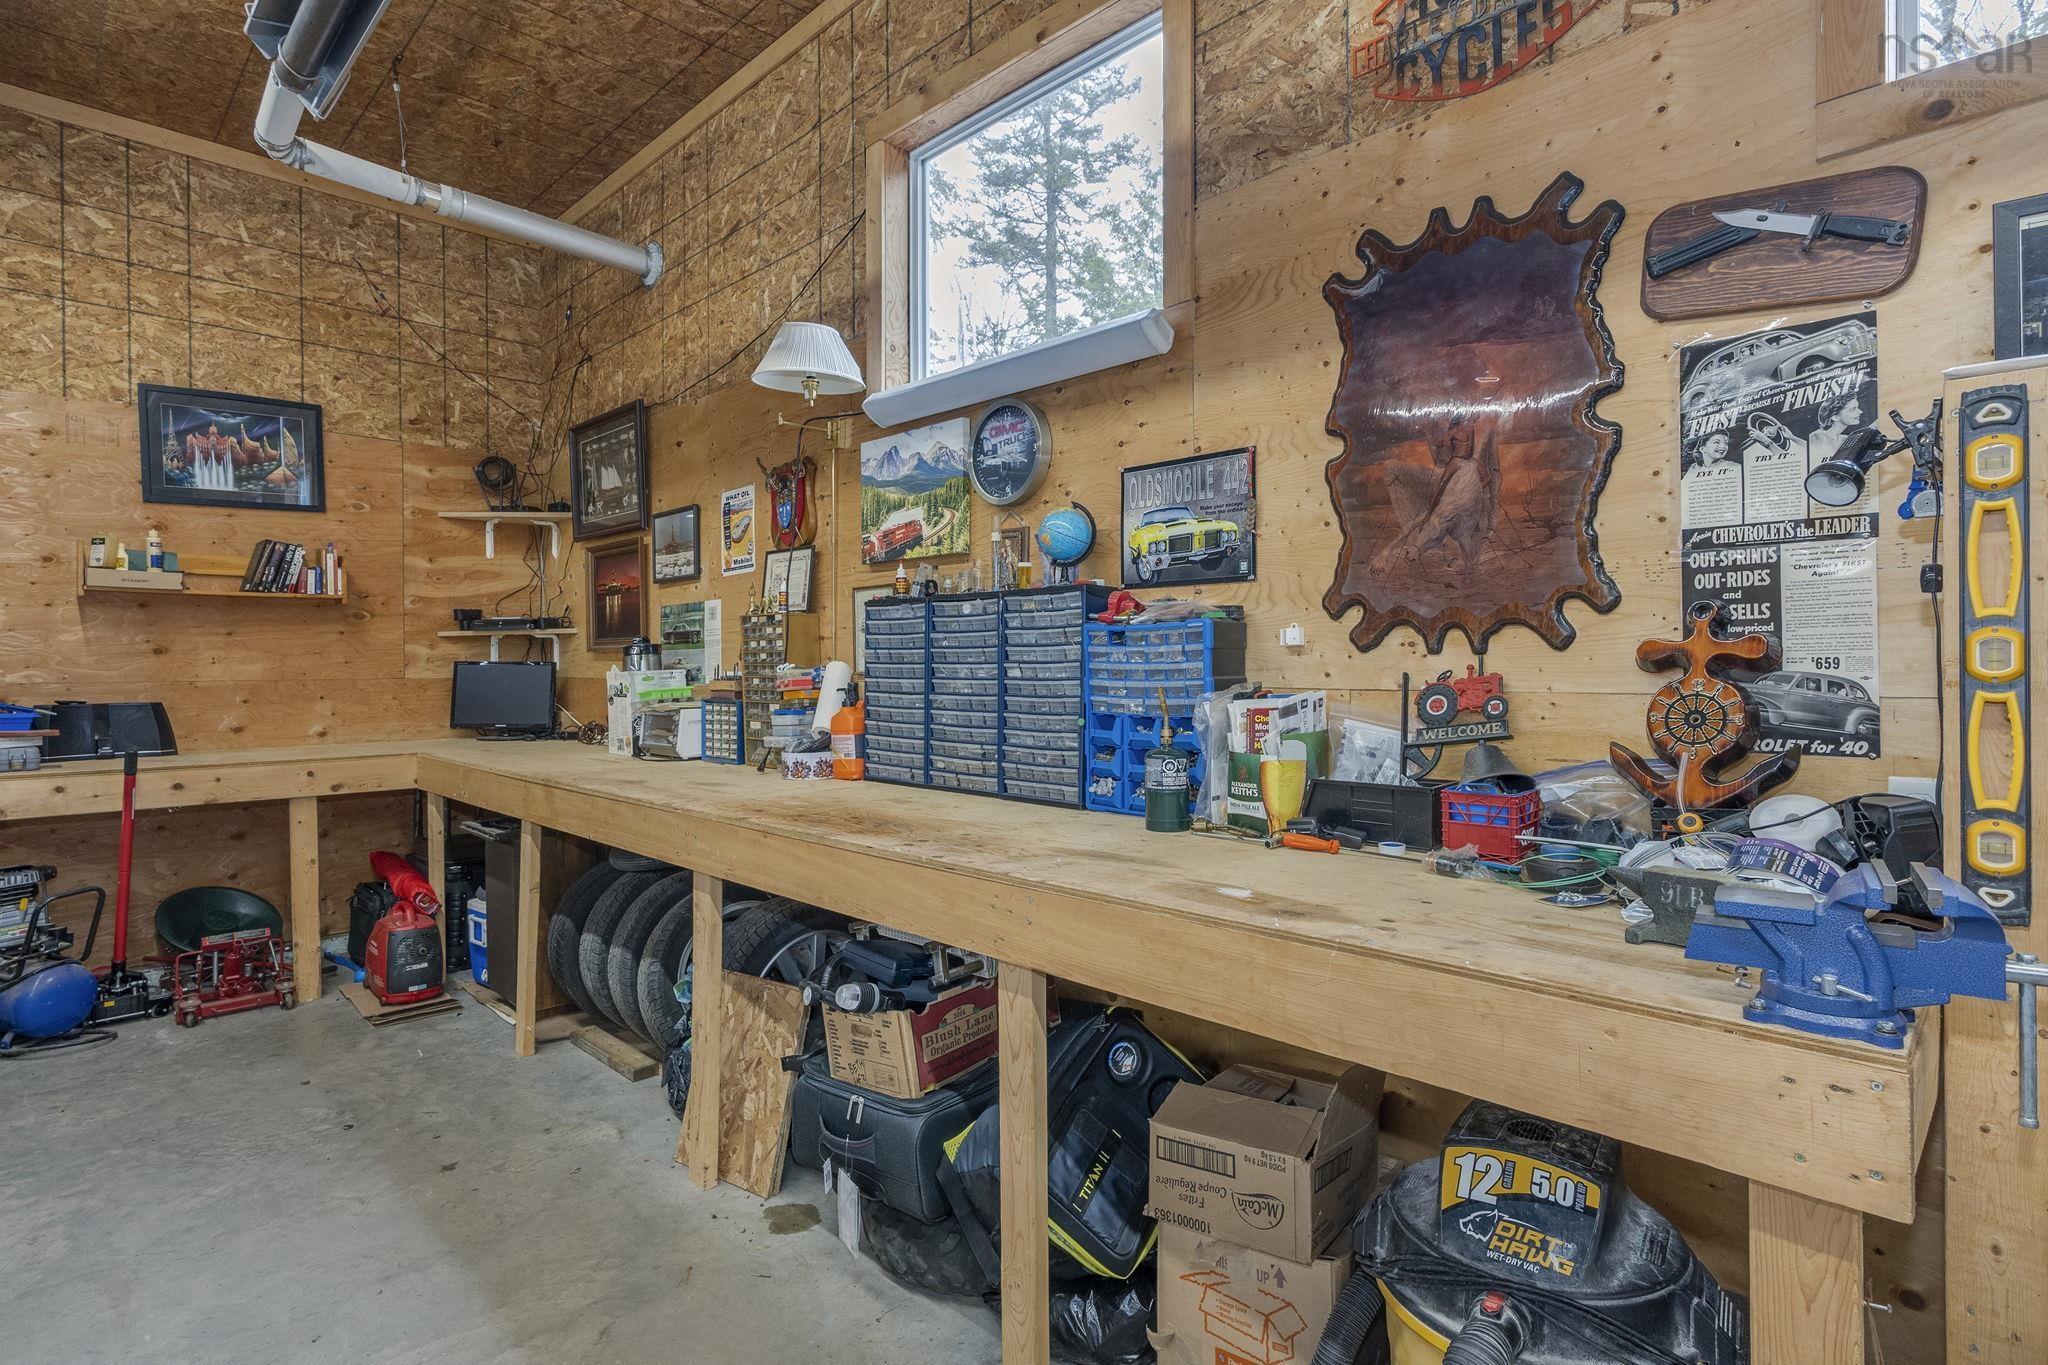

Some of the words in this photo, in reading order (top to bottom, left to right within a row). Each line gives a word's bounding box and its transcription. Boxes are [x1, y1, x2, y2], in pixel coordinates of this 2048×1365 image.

[989, 418, 1027, 438] GMC
[1755, 455, 1774, 463] TRY
[1696, 469, 1714, 478] EYE
[1129, 464, 1214, 510] OLDSMOBILE
[1223, 457, 1249, 495] 442
[725, 492, 740, 502] WHAT
[741, 490, 750, 498] OIL
[1711, 520, 1795, 545] CHEVROLET'S
[1796, 525, 1815, 538] the
[1814, 516, 1871, 536] LEADER
[1689, 547, 1778, 569] OUT-SPRINTS
[1694, 569, 1771, 590] OUT-RIDES
[1722, 590, 1742, 600] and
[1727, 622, 1774, 635] low-priced
[1811, 656, 1840, 670] $659
[1422, 722, 1503, 740] WELCOME
[1810, 740, 1836, 754] for
[1231, 780, 1258, 789] ALEXANDER
[1231, 786, 1259, 797] KEITH'S
[923, 1025, 962, 1048] Blush
[964, 1011, 994, 1031] Lane
[930, 1037, 962, 1057] Organic
[963, 1023, 992, 1043] Produce
[1244, 1155, 1252, 1164] kg
[1256, 1158, 1268, 1169] NET
[1268, 1161, 1287, 1173] POIDS
[1079, 1163, 1103, 1199] TITAN
[1454, 1152, 1504, 1205] 12
[1503, 1160, 1515, 1188] GALLON
[1155, 1175, 1197, 1193] Régulière
[1198, 1183, 1227, 1199] Coupe
[1531, 1168, 1575, 1207] 5.0
[1577, 1182, 1587, 1193] HP
[1178, 1193, 1206, 1208] Frites
[1236, 1197, 1279, 1218] McCain
[1575, 1193, 1587, 1212] PEAK
[1154, 1207, 1212, 1234] 1000001363
[1495, 1220, 1563, 1251] DIRT
[1486, 1250, 1521, 1267] WET-DRY
[1523, 1261, 1540, 1274] VAC
[1488, 1235, 1575, 1276] HAWG
[1256, 1268, 1270, 1284] UP
